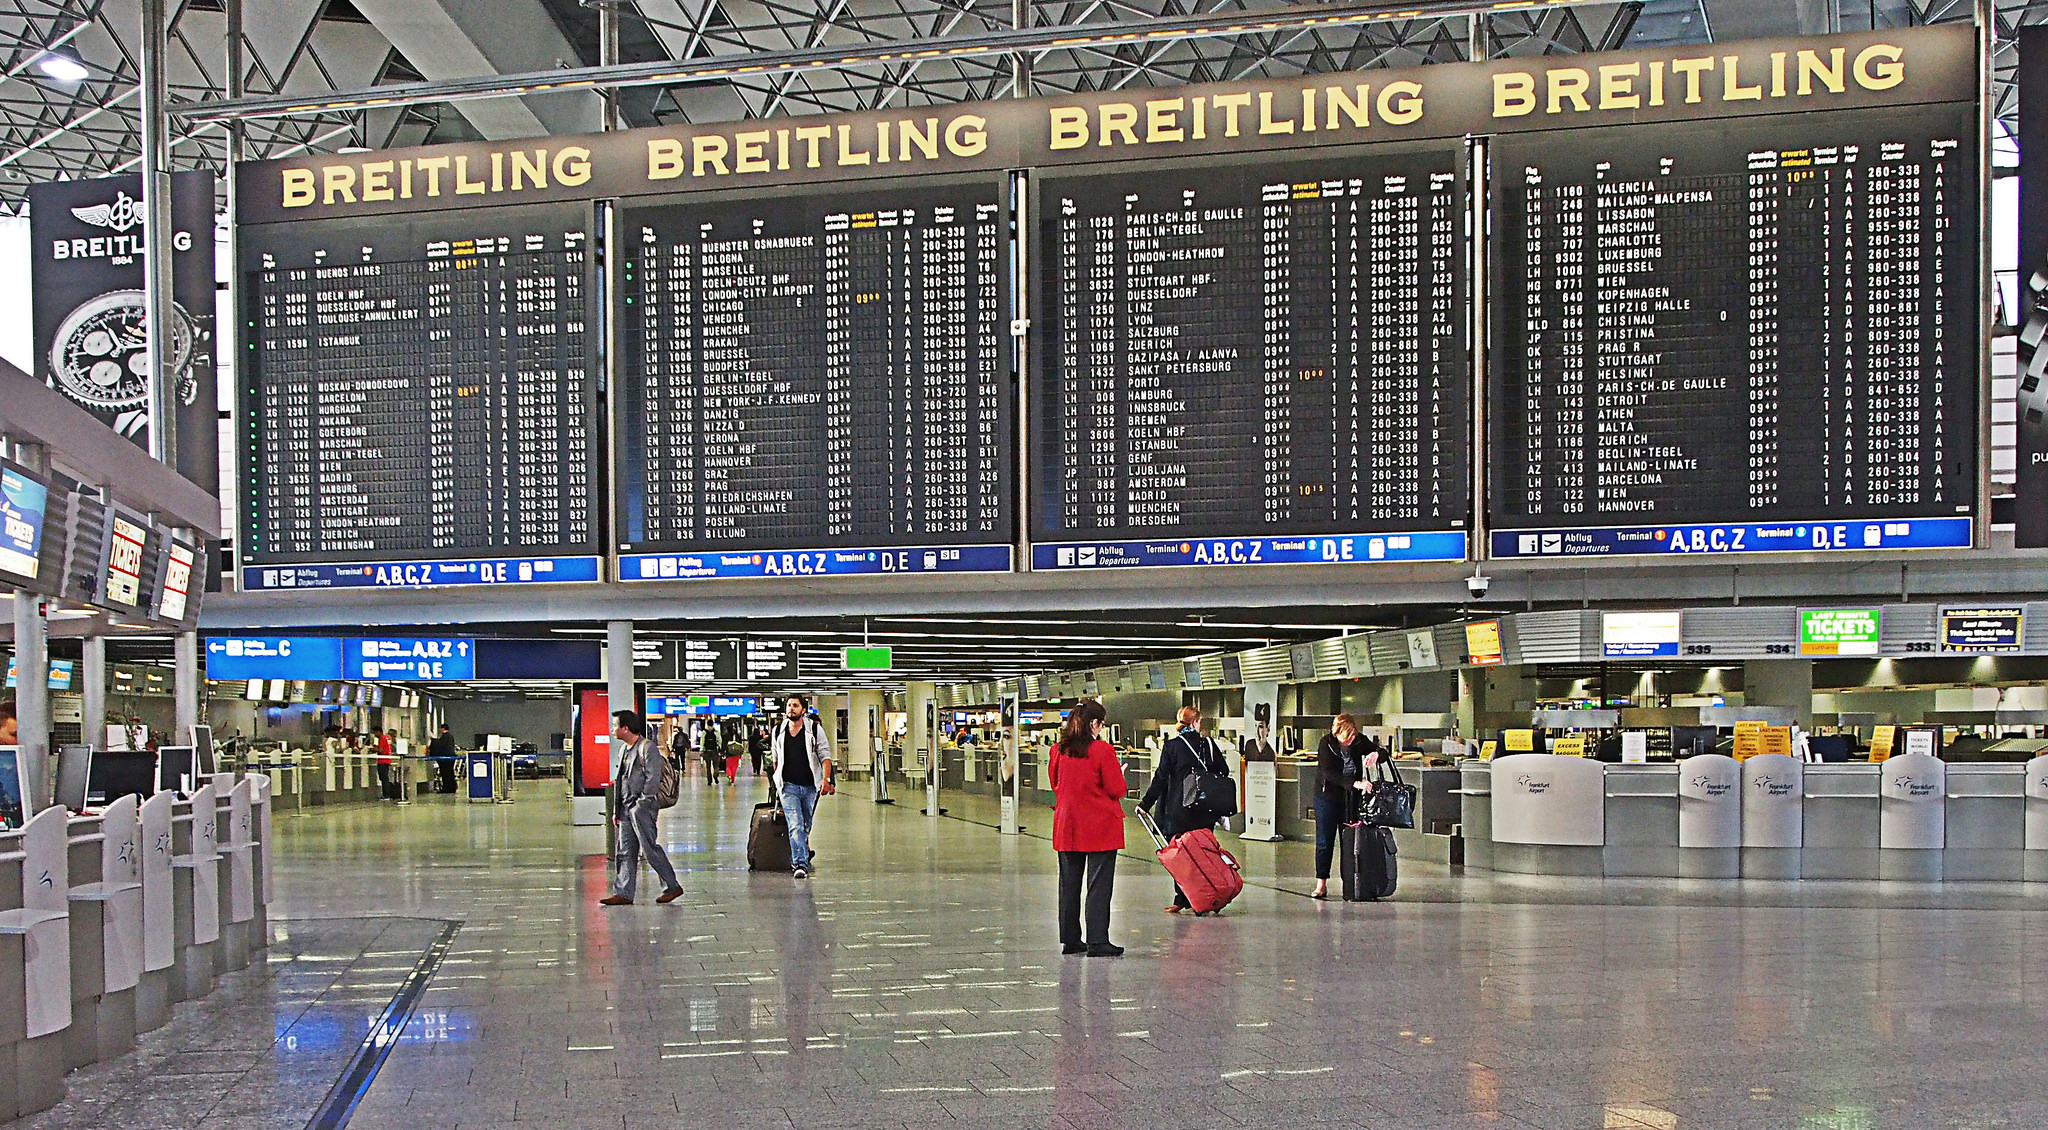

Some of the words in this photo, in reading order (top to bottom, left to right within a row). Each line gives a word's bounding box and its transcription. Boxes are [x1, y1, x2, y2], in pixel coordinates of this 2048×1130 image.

[1493, 44, 1905, 117] BREITLING
[1049, 80, 1425, 150] BREITLING
[647, 114, 989, 180] BREITLING
[282, 146, 592, 206] BREITLING
[1597, 180, 1655, 195] VALENCIA
[1597, 190, 1713, 208] MAILAND-MALPENSA
[1204, 207, 1243, 221] GAULLE
[1597, 207, 1655, 222] LISSABON
[1126, 223, 1204, 238] BERLIN-TEGEL
[1597, 221, 1655, 235] WARSCHAU
[53, 232, 192, 259] BREITLG
[1126, 238, 1159, 251] TURIN
[1597, 233, 1661, 248] CHARLOTTE
[701, 252, 744, 266] BOLOGNA
[1127, 247, 1224, 264] LONDON-HEATHROW
[1597, 247, 1662, 261] LUXEMBURG
[316, 267, 349, 279] BUENOS
[353, 265, 381, 277] AIRES
[702, 263, 755, 277] MARSEILLE
[1127, 264, 1153, 276] WIEN
[1597, 261, 1654, 275] BRUESSEL
[1127, 275, 1185, 289] STUTTGART
[702, 287, 767, 301] LONDON-CITY
[772, 284, 814, 297] AIRPORT
[1127, 287, 1198, 301] DUESSELDORF
[1597, 287, 1669, 301] KOPENHAGEN
[702, 300, 744, 313] CHICAGO
[1127, 302, 1153, 314] LINZ
[1655, 299, 1690, 311] HALLE
[702, 312, 744, 325] VENEDIG
[1128, 314, 1153, 326] LYON
[1598, 314, 1655, 327] CHISINAU
[1128, 325, 1179, 339] SALZBURG
[1598, 327, 1655, 340] PRISTINA
[703, 337, 738, 349] KRAKAU
[1127, 338, 1173, 351] ZUERICH
[1597, 342, 1626, 354] PRAG
[703, 348, 750, 361] BRUESSEL
[1127, 351, 1180, 364] GAZIPASA
[1198, 348, 1238, 360] ALANYA
[1598, 353, 1662, 367] STUTTGART
[1128, 364, 1160, 376] SANKT
[1166, 361, 1231, 374] PETERSBURG
[1598, 367, 1653, 380] HELSINKI
[1128, 376, 1160, 388] PORTO
[1597, 379, 1676, 393] PARIS-CH.DE
[1683, 377, 1726, 390] GAULLE
[1128, 389, 1173, 401] HAMBURG
[1598, 394, 1647, 407] DETROIT
[703, 397, 722, 408] NEW
[1129, 401, 1186, 414] INNSBRUCK
[1128, 414, 1167, 426] BREMEN
[1597, 408, 1634, 420] ATHEN
[319, 416, 351, 426] ANKARA
[1598, 421, 1634, 433] MALTA
[703, 432, 740, 444] VERONA
[1129, 439, 1179, 451] ISTANBUL
[704, 455, 751, 467] HANNOVER
[1128, 452, 1153, 464] GENF
[1128, 464, 1186, 476] LJUBLJANA
[1598, 459, 1697, 472] MAILAND-LINATE
[704, 469, 728, 480] GRAZ
[1598, 473, 1662, 486] BARCELONA
[1128, 476, 1186, 489] AMSTERDAM
[705, 490, 793, 503] FRIEDRICHSHAFEN
[1128, 490, 1167, 501] MADRID
[1598, 488, 1627, 499] WIEN
[1128, 502, 1180, 514] MUENCHEN
[705, 516, 735, 527] POSEN
[1128, 515, 1180, 526] DRESDENH
[321, 529, 359, 540] ZUERICH
[705, 528, 746, 539] BILLUND
[1565, 533, 1593, 544] Abflug
[1617, 531, 1653, 542] Terminal
[1670, 528, 1746, 552] A,B,C,Z
[1756, 527, 1794, 538] Terminal
[1812, 525, 1847, 549] D,E
[1099, 546, 1124, 557] Abflug
[1146, 544, 1178, 554] Terminal
[1194, 542, 1262, 564] A,B,C,Z
[1271, 541, 1305, 551] Terminal
[1322, 539, 1354, 562] D,E
[1565, 543, 1610, 554] Departures
[721, 556, 751, 566] Terminal
[764, 554, 827, 576] A,B,C,Z
[835, 553, 866, 562] Terminal
[881, 552, 909, 572] D,E
[1099, 556, 1140, 566] Departures
[336, 568, 363, 576] Terminal
[376, 565, 432, 586] A,B,C,Z
[439, 564, 467, 573] Terminal
[480, 563, 507, 583] D,E
[1812, 611, 1834, 619] LAST
[1805, 619, 1876, 635] TICKETS
[278, 640, 291, 656] C
[1687, 645, 1711, 655] 535
[1766, 645, 1790, 654] 534
[1906, 642, 1931, 652] 533
